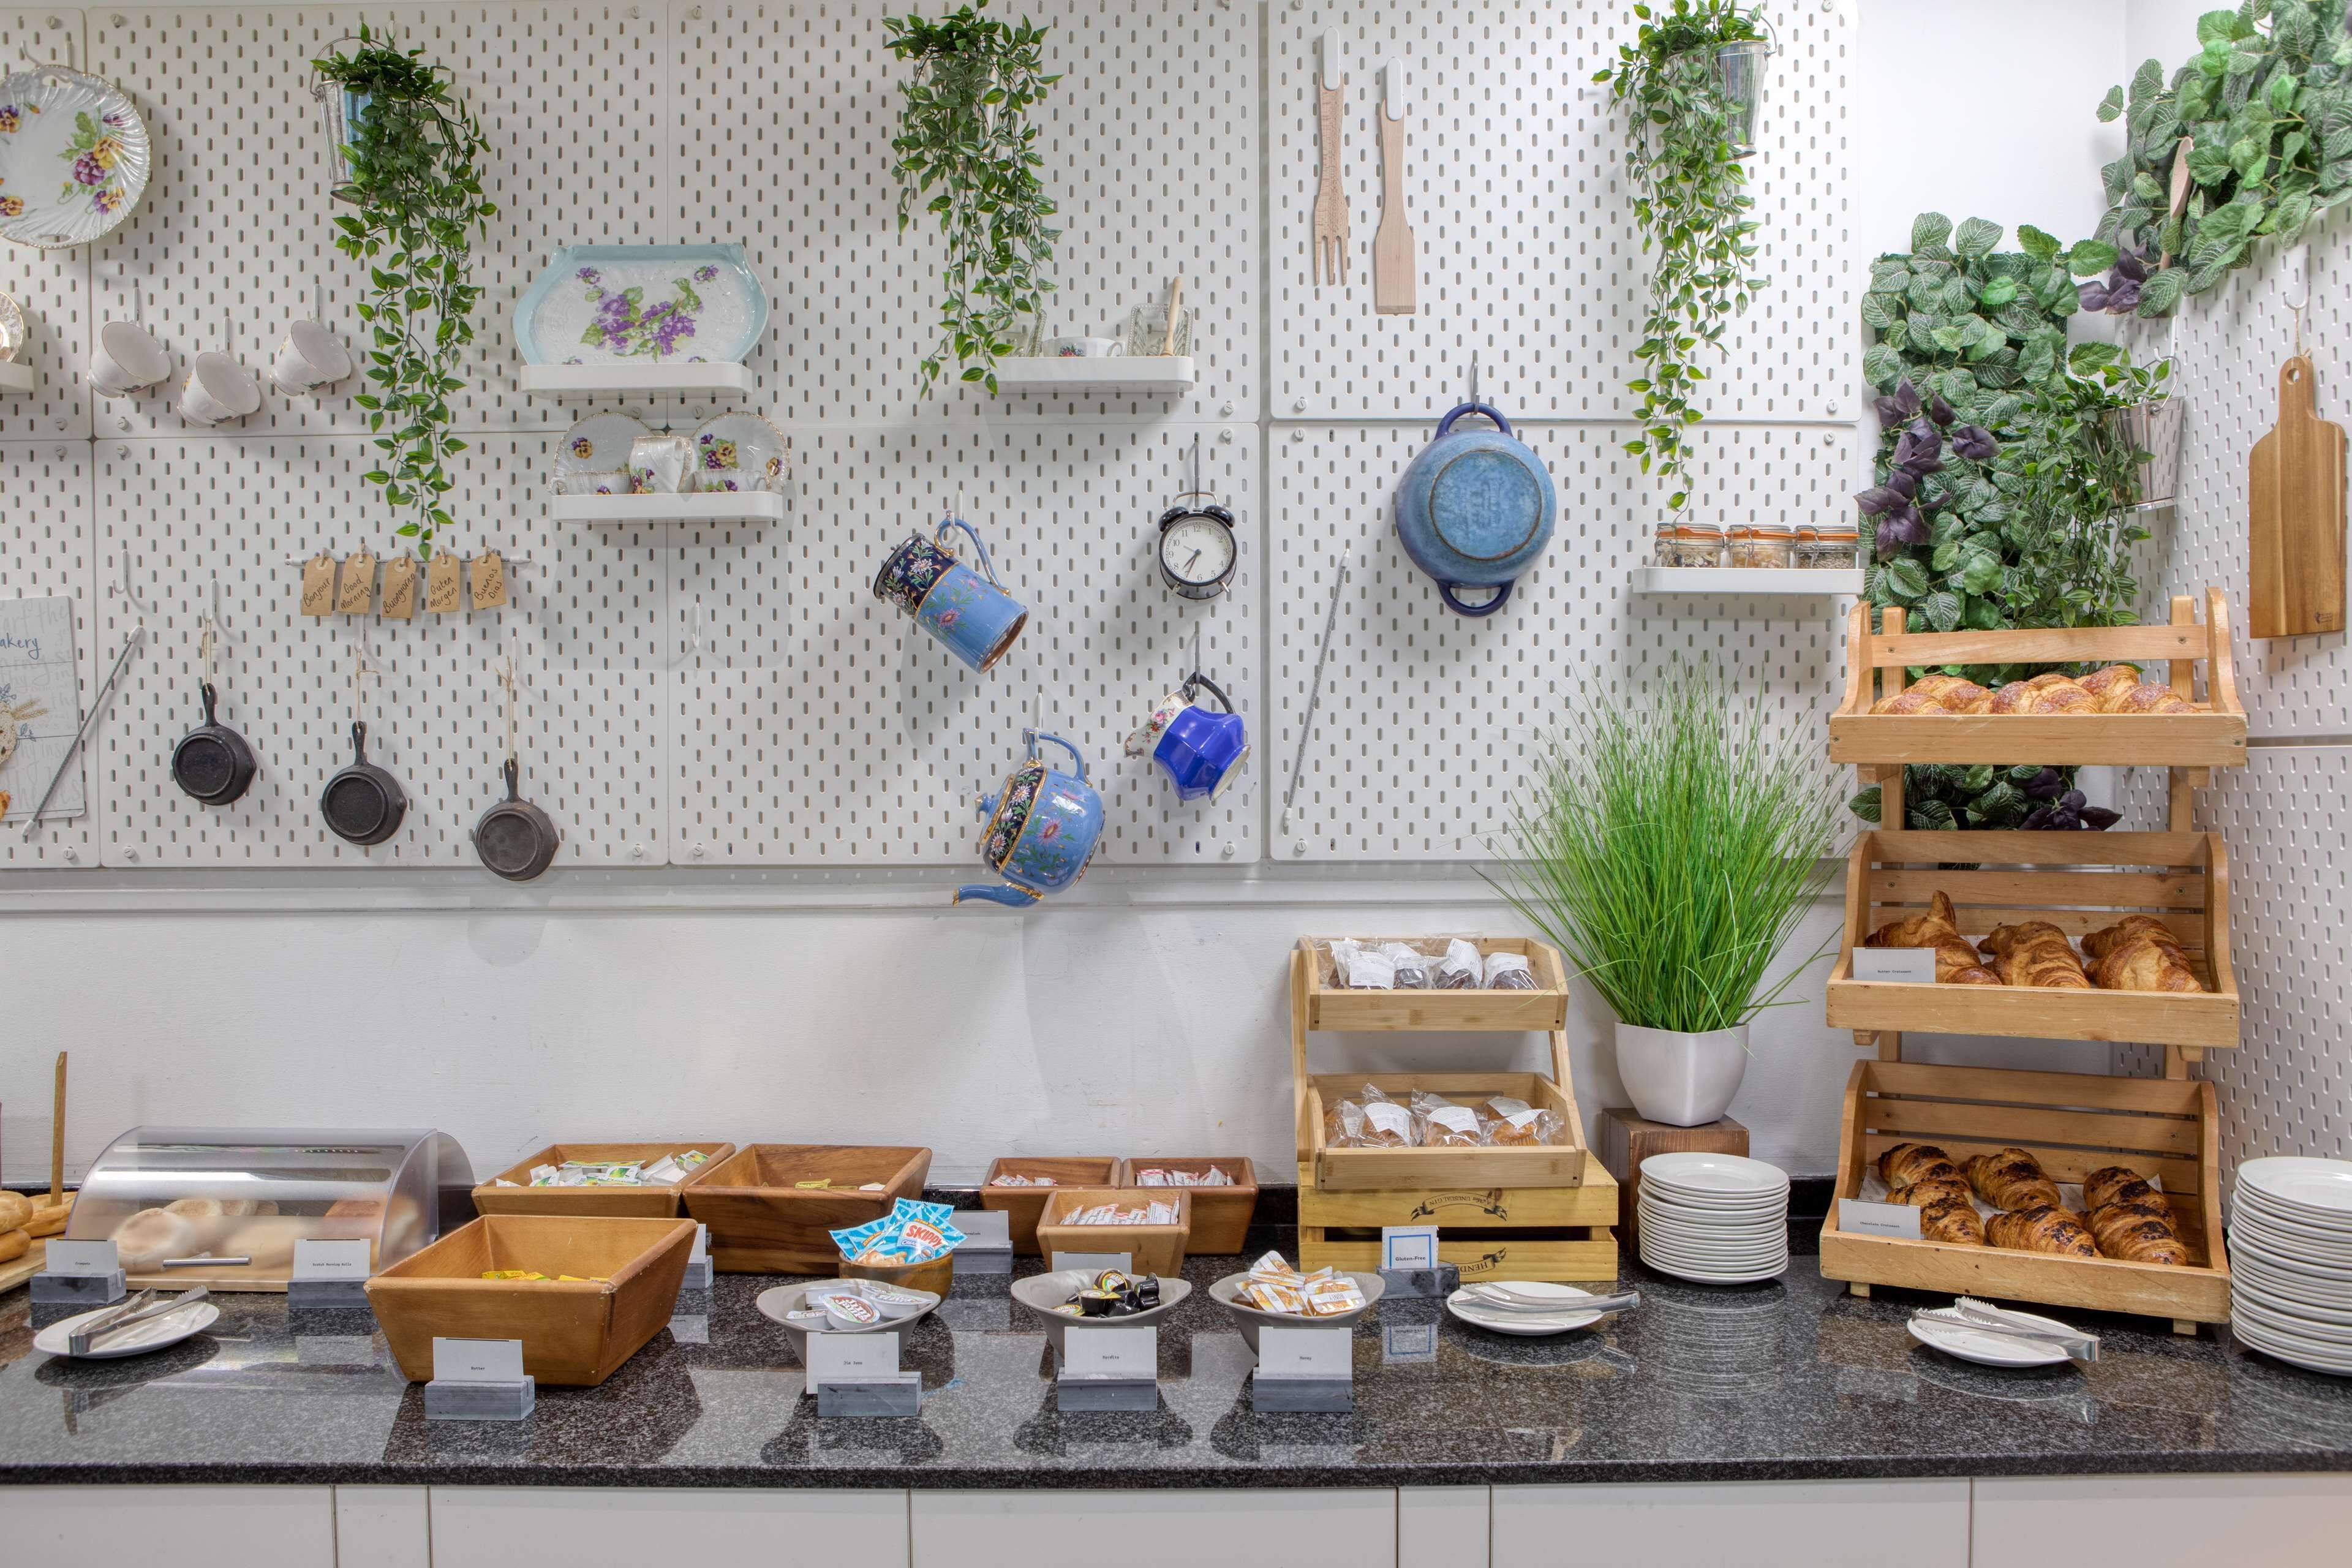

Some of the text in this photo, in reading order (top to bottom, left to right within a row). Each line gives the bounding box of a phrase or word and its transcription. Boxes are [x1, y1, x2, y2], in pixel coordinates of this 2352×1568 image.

[303, 578, 331, 607] Bonjour
[344, 573, 364, 594] Good
[383, 573, 415, 614] Buongiorno
[431, 576, 454, 595] Guten
[474, 568, 498, 601] Buenos
[488, 581, 502, 599] Dias
[341, 586, 372, 610] Morning
[430, 587, 457, 608] Morgen
[1429, 1196, 1442, 1206] GIN
[906, 1225, 942, 1248] SKIPPY
[1459, 1262, 1488, 1273] HEND
